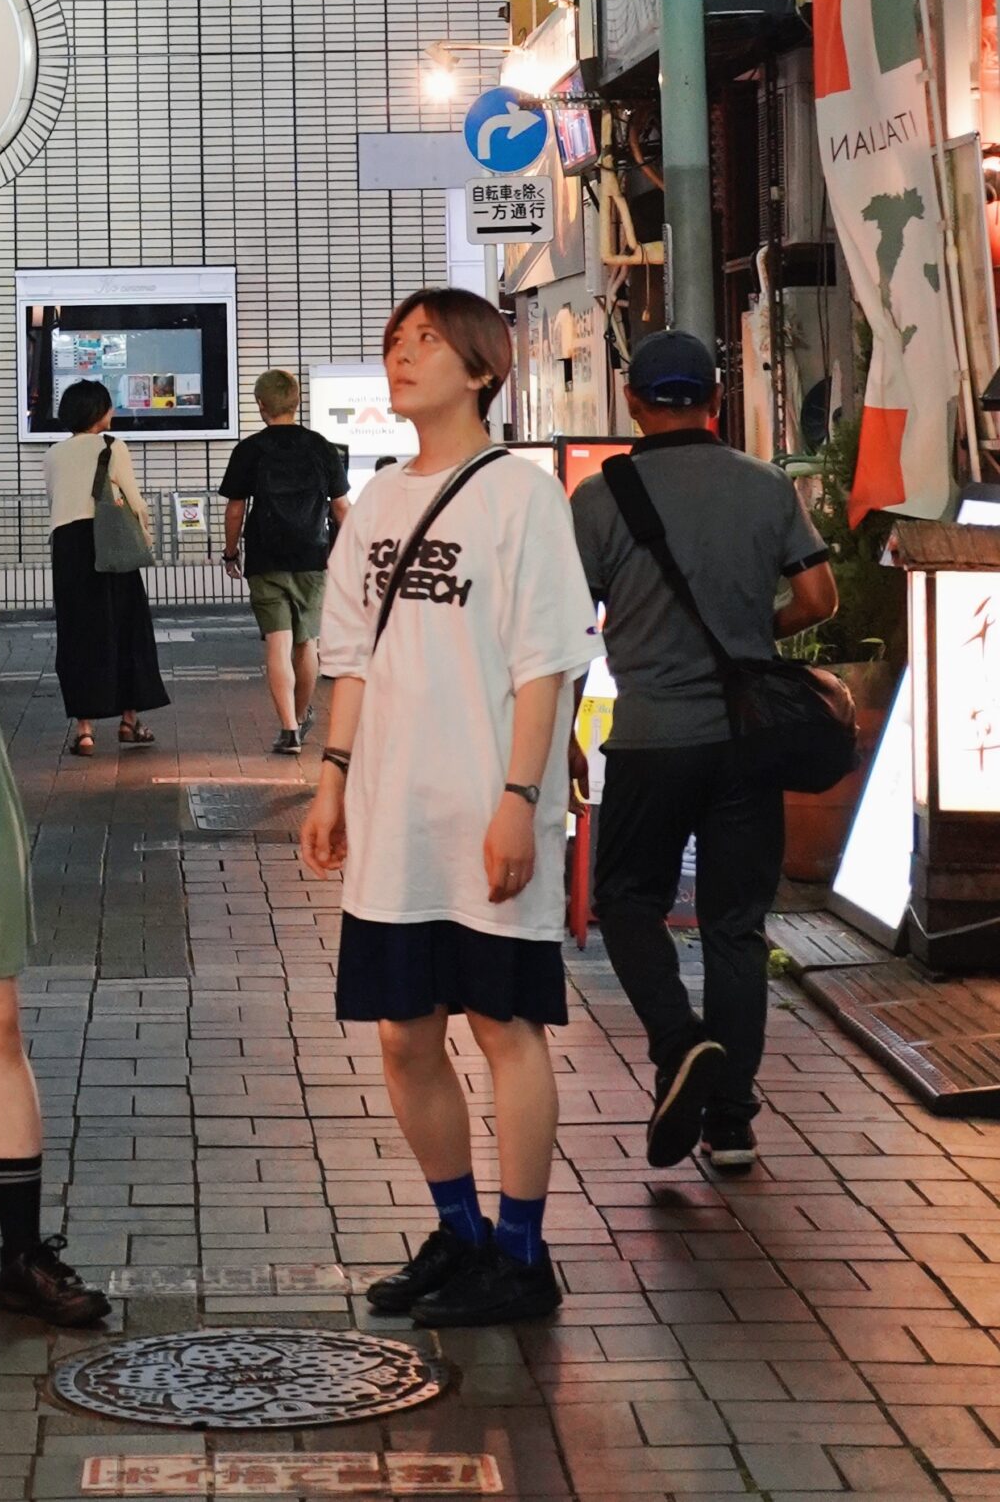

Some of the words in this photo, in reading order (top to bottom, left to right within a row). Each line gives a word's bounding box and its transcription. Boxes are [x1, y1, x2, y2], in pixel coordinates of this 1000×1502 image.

[472, 183, 545, 202] 自転車を除く
[472, 202, 546, 220] 一方通行
